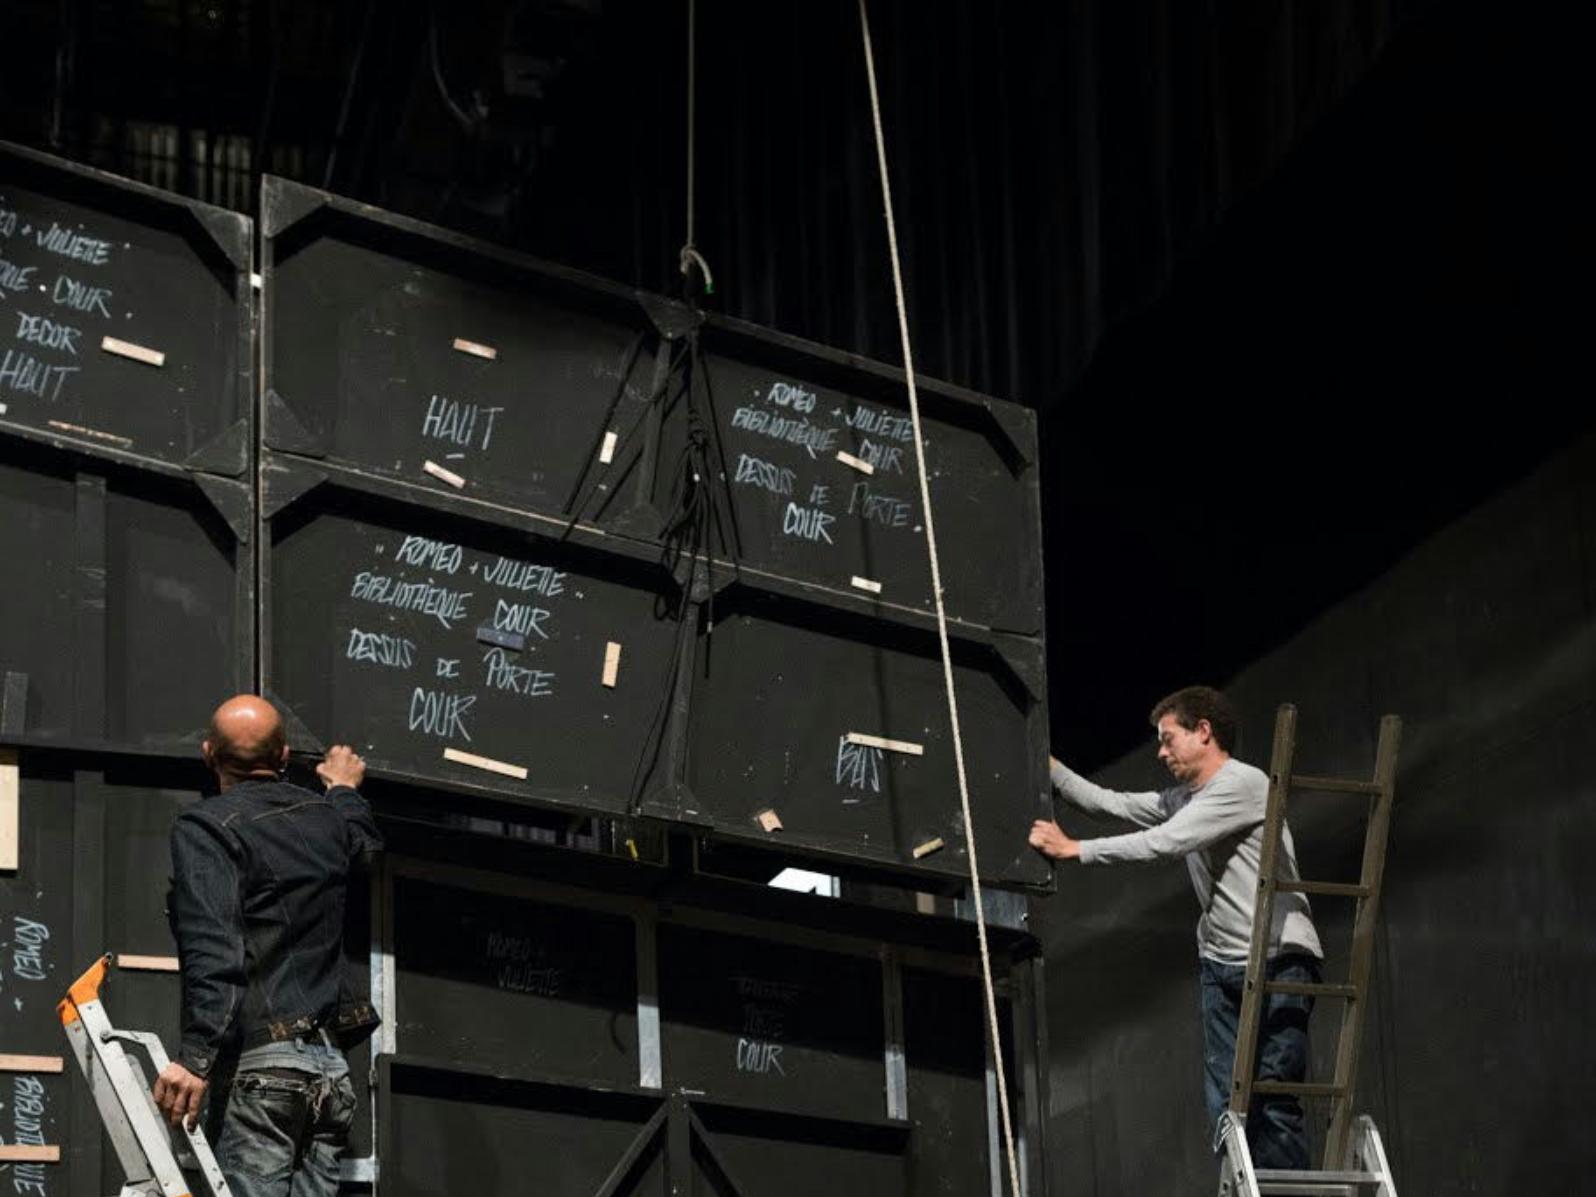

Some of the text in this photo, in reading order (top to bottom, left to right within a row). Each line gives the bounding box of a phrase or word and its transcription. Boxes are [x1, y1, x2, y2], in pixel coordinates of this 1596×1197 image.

[53, 274, 113, 319] COUR
[16, 310, 83, 355] DECOR
[0, 349, 81, 401] HAUT
[422, 394, 504, 450] HAUT
[734, 453, 797, 495] DESSUS
[783, 501, 837, 545] COUR
[493, 598, 549, 640] COUR
[346, 627, 556, 696] DESSUS DE PORTE
[408, 687, 477, 742] COUR
[735, 1037, 786, 1077] COUR
